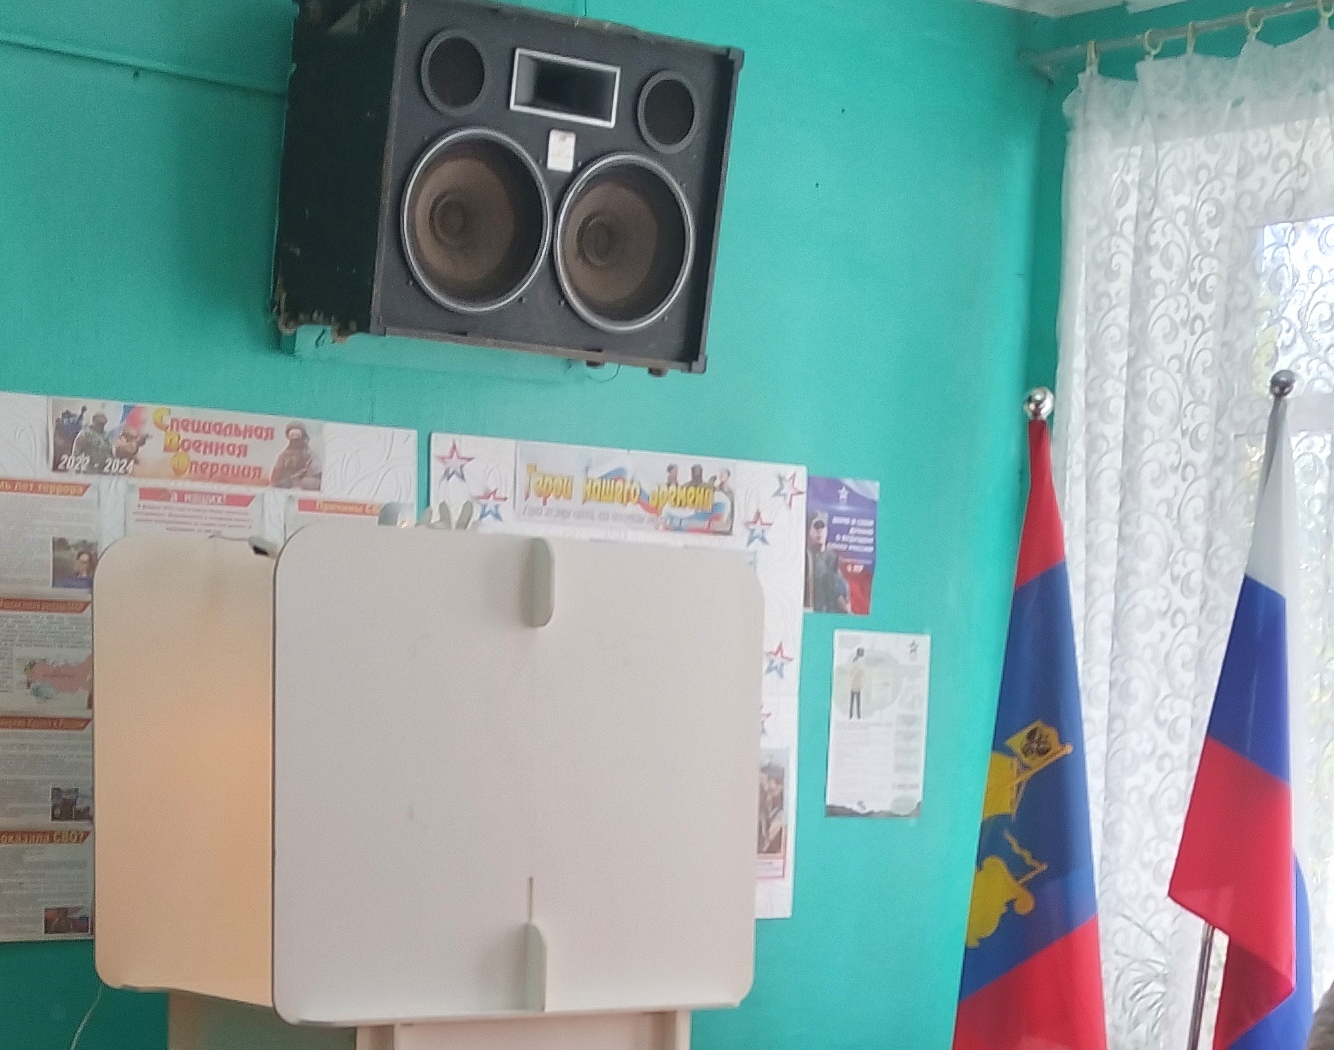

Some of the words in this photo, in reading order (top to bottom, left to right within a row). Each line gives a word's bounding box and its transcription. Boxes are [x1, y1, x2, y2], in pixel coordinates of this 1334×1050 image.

[152, 407, 276, 441] Специальная
[163, 430, 249, 458] Военная
[171, 451, 264, 480] Операция
[14, 480, 35, 492] лет
[581, 474, 641, 507] нашего
